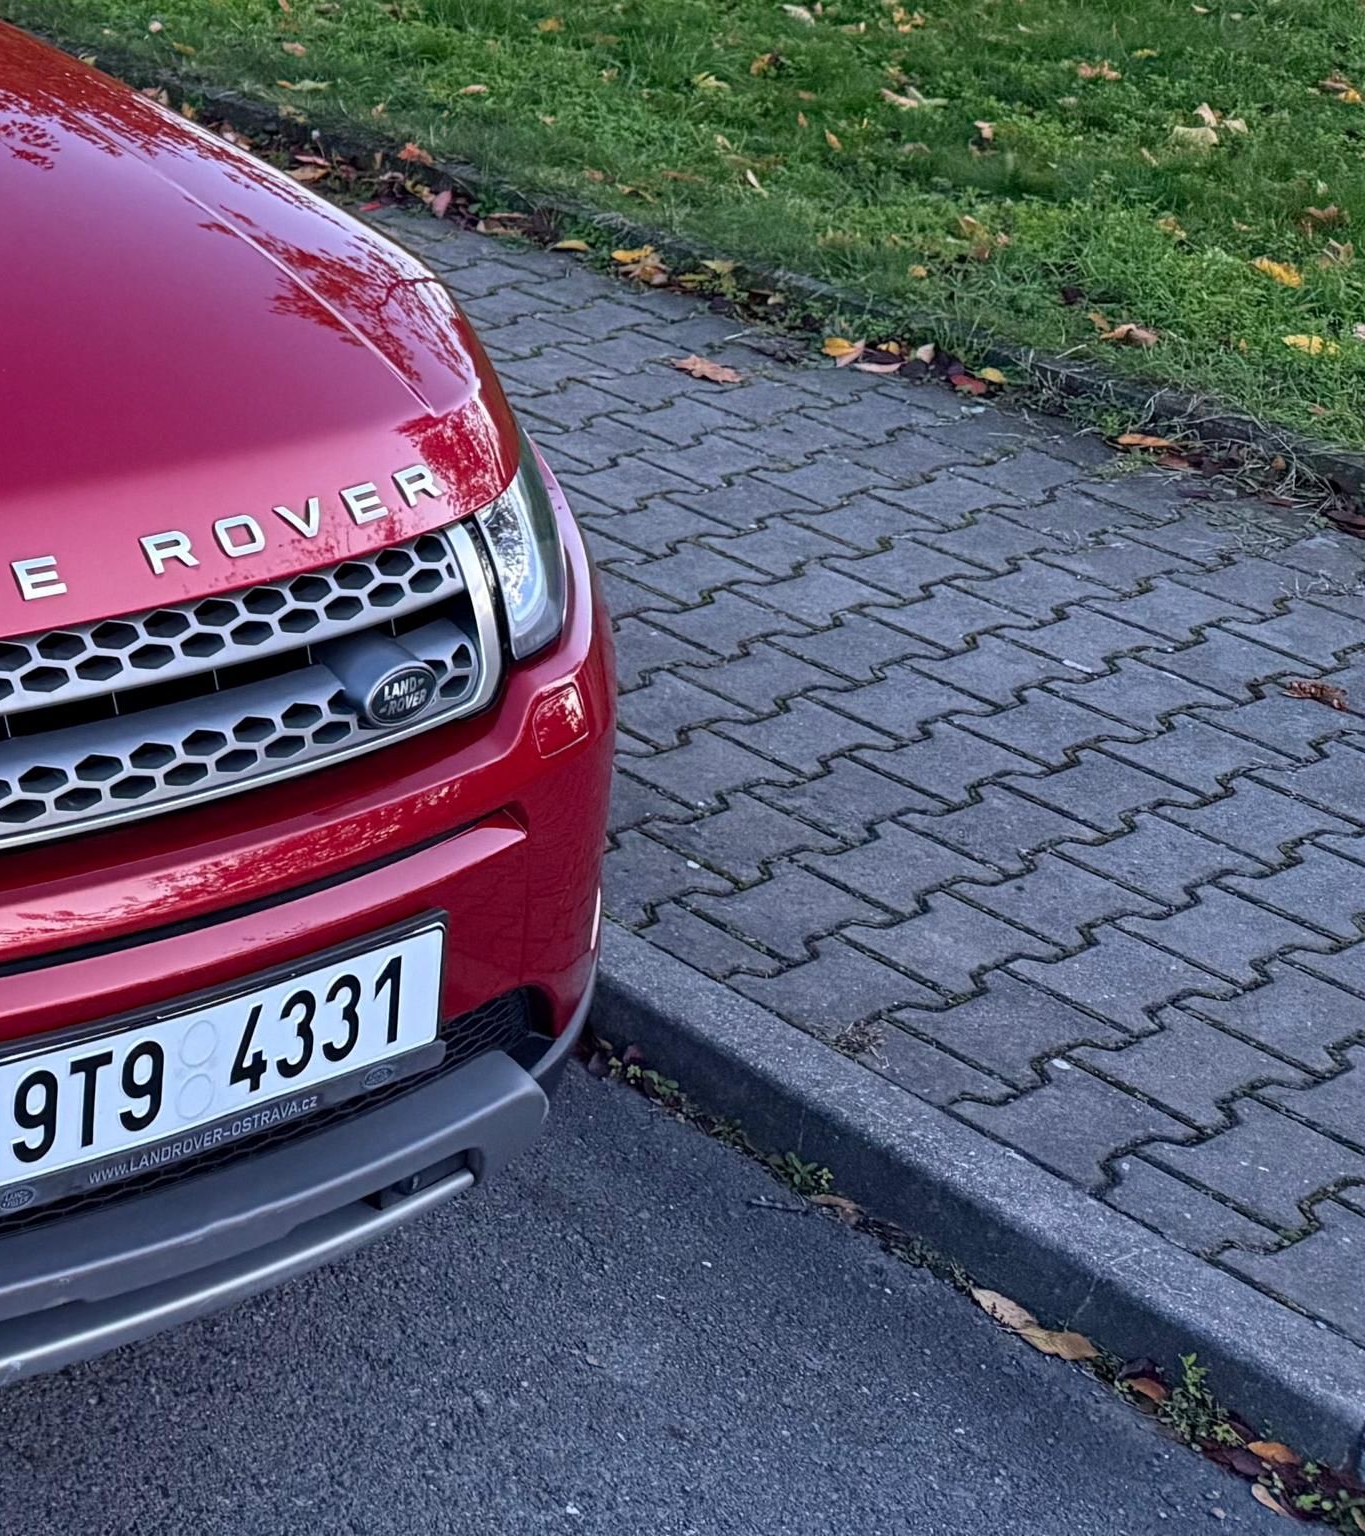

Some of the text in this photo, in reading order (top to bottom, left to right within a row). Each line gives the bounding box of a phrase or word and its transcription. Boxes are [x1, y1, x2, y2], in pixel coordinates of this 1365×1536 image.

[139, 465, 444, 575] ROVER
[384, 676, 417, 701] LAND
[387, 688, 428, 716] ROVER
[11, 955, 403, 1163] 9T9 4331
